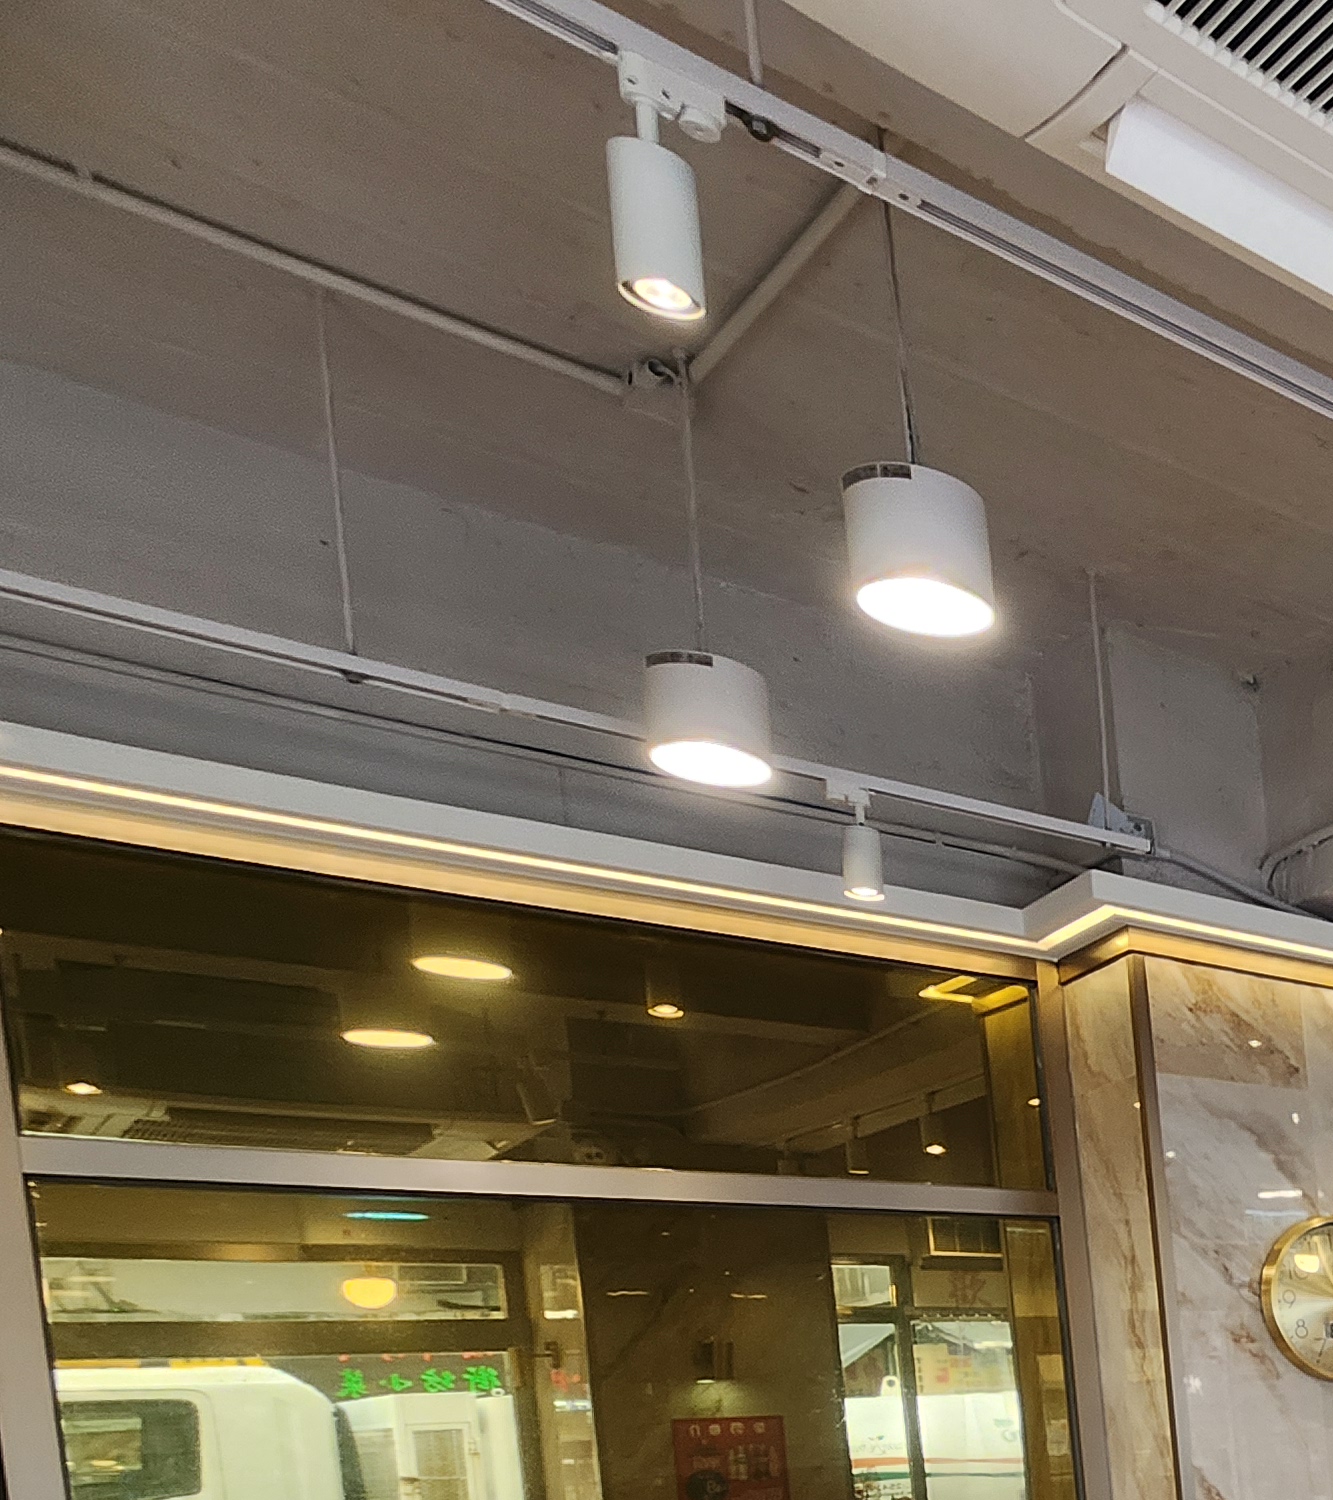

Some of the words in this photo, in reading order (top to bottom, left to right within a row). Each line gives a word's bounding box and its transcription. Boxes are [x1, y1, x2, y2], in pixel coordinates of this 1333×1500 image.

[1282, 1289, 1296, 1308] 9
[1295, 1319, 1308, 1339] 8
[1314, 1337, 1327, 1357] 7
